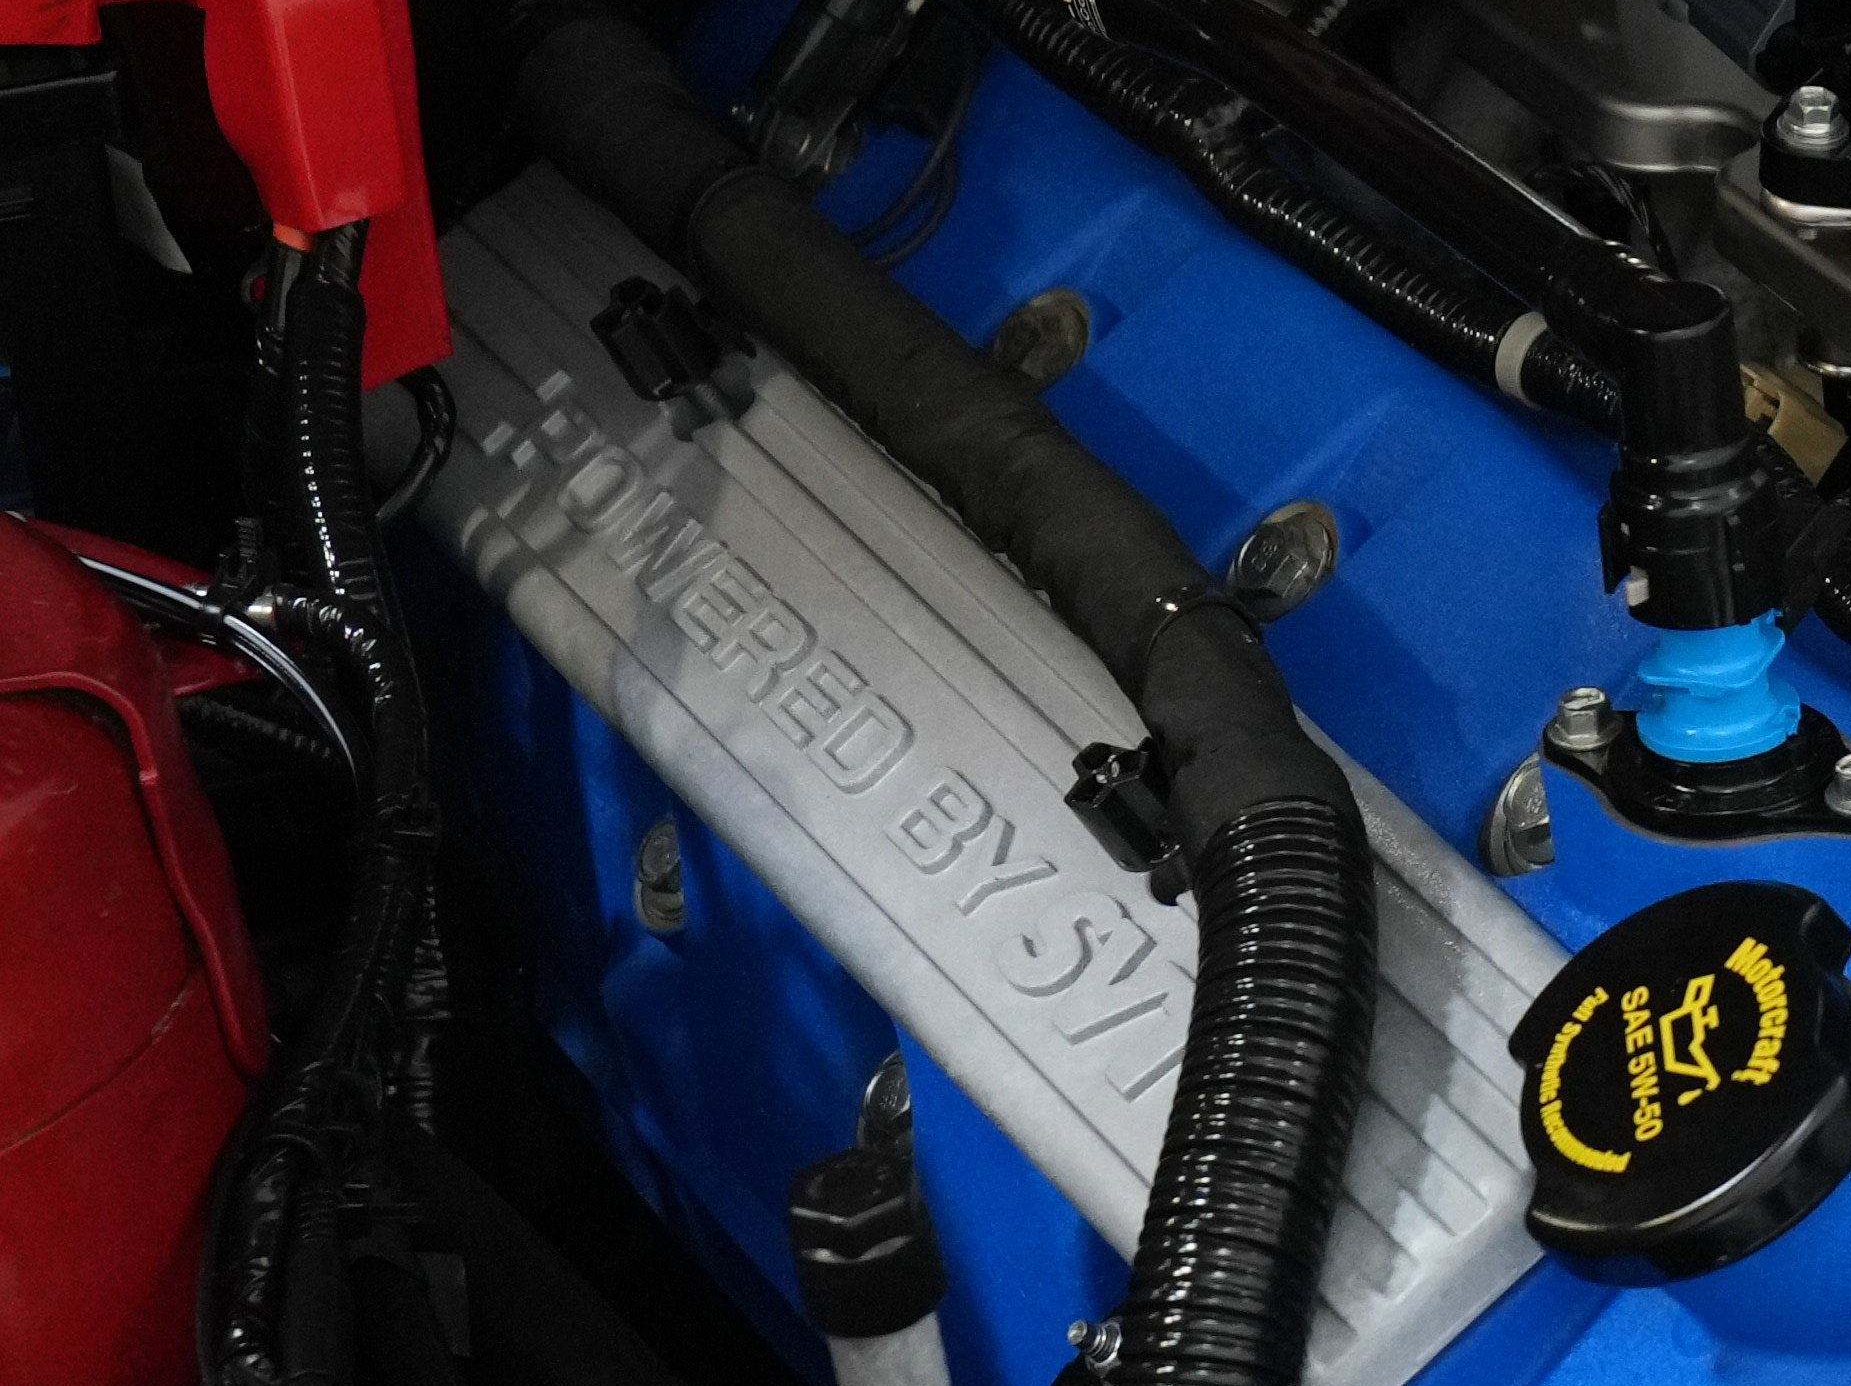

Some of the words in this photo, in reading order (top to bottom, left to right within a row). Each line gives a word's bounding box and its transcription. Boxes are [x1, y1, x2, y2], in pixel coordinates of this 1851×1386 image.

[500, 403, 918, 797] POWERED
[884, 763, 1060, 915] BY
[1620, 985, 1655, 1054] SAE
[1723, 936, 1789, 1086] Motorcraft
[1627, 1051, 1664, 1142] 5W-50
